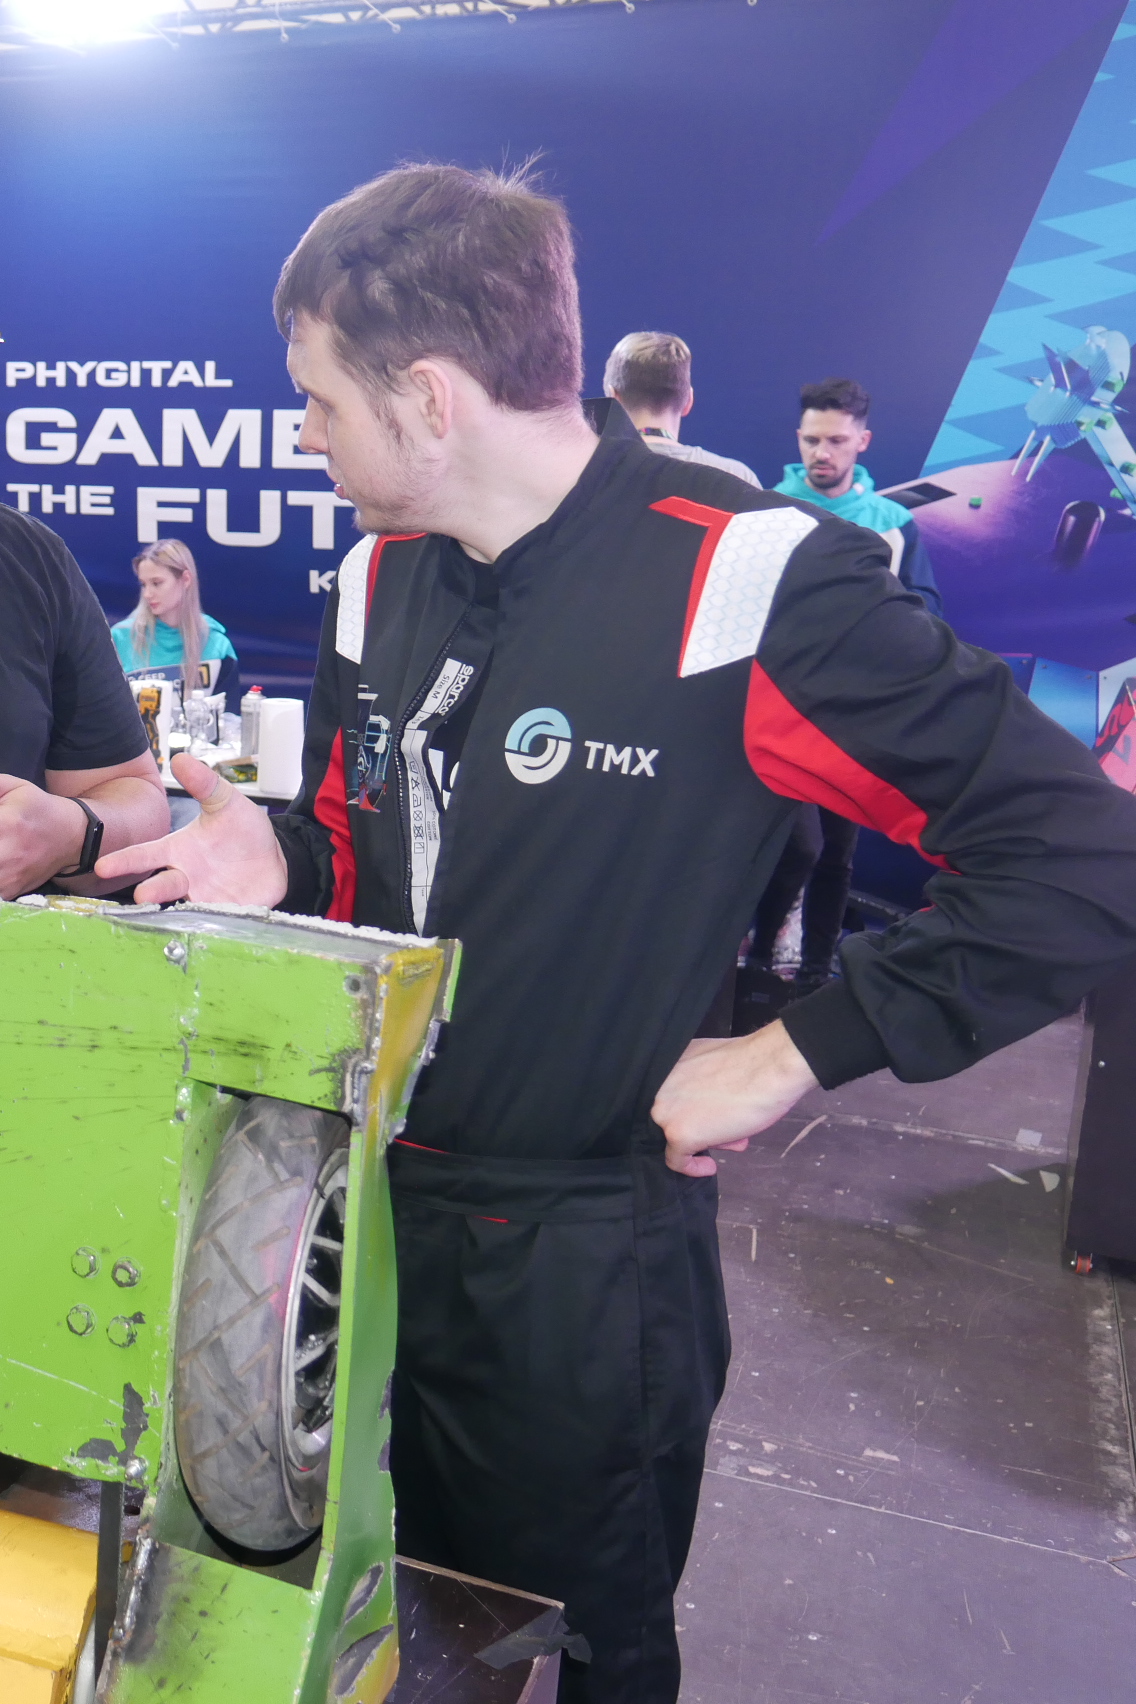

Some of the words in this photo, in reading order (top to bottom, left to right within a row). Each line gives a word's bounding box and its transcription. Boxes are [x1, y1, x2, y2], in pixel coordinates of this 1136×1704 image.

[6, 361, 233, 387] PHYGITAL
[6, 407, 328, 470] GAME
[6, 483, 115, 515] THE
[137, 487, 353, 550] FUT
[431, 690, 441, 700] M
[437, 674, 450, 690] Size
[584, 740, 659, 777] TMX
